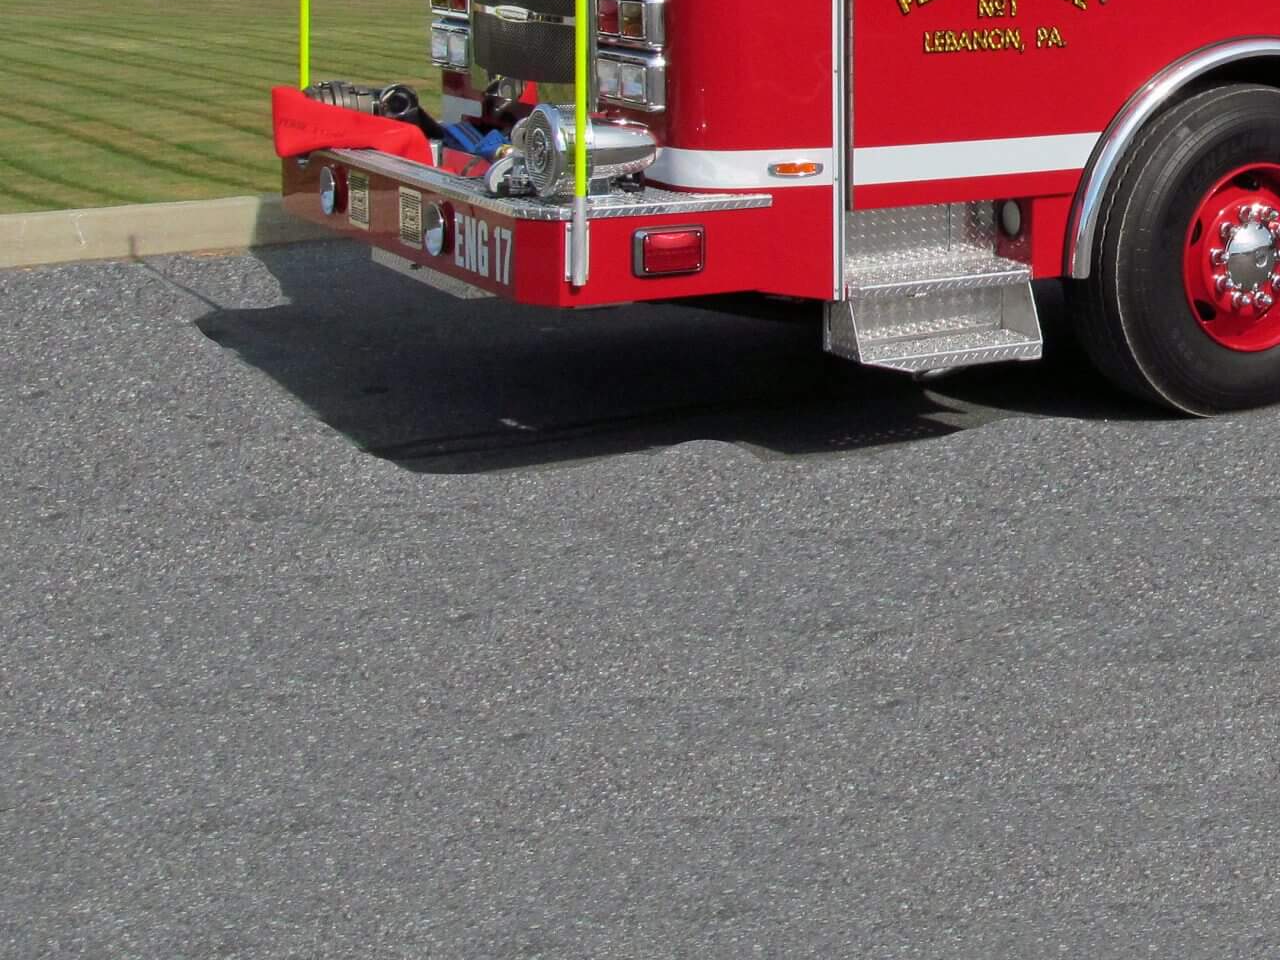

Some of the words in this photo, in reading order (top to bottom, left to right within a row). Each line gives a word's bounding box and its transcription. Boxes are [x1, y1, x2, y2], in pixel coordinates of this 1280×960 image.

[924, 28, 1025, 53] LEBANON,
[1036, 26, 1067, 49] PA.
[454, 212, 488, 277] ENG
[494, 226, 512, 285] 17
